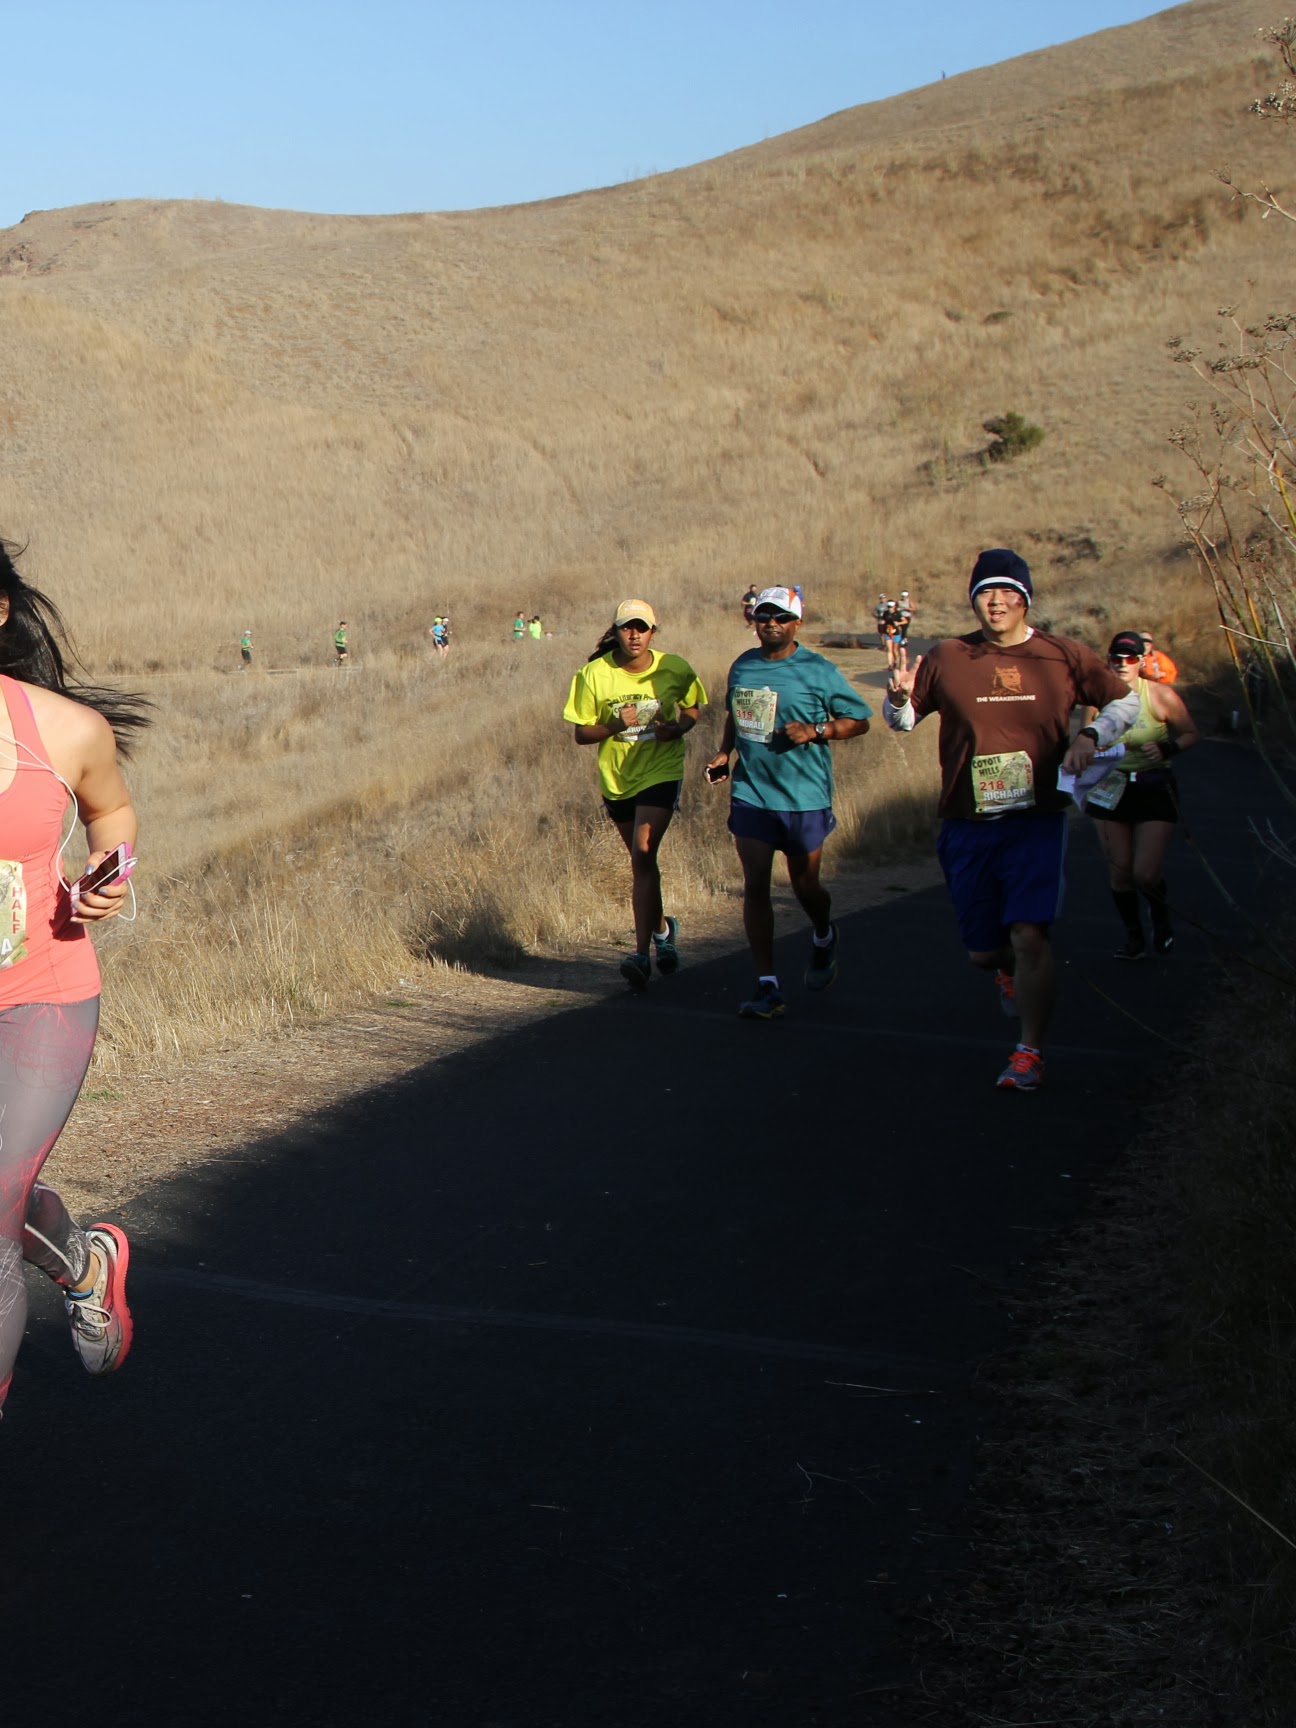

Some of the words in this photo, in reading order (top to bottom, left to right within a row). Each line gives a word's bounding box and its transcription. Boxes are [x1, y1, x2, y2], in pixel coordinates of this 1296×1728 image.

[735, 689, 754, 697] COYOTE
[736, 709, 753, 719] 315
[738, 719, 764, 729] MURALI
[972, 756, 1001, 768] COYOTE
[978, 766, 1000, 777] HILLS
[979, 780, 1005, 791] 218
[984, 788, 1026, 800] RICHARD
[11, 886, 23, 934] HALF
